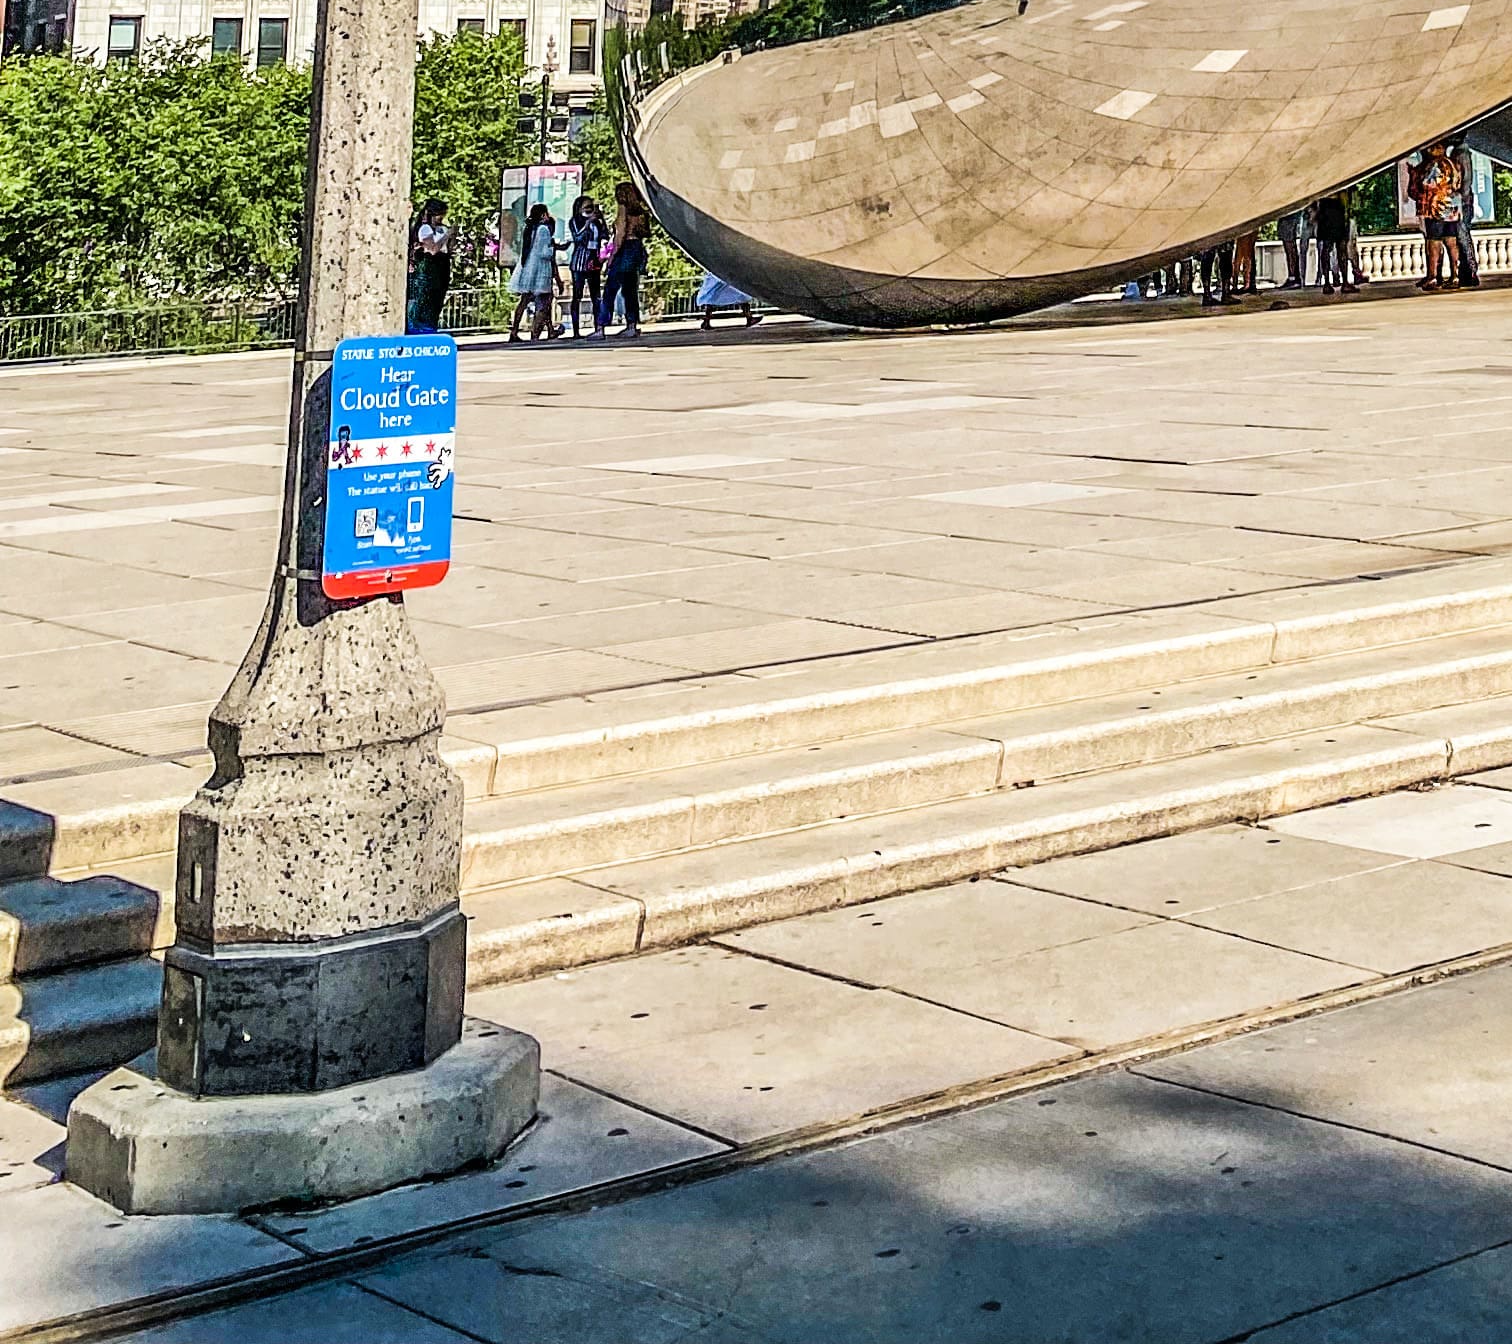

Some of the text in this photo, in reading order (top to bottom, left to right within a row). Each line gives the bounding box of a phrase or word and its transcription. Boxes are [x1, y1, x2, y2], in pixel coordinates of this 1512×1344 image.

[342, 349, 375, 360] STATUE
[414, 345, 451, 356] CHICAGO
[381, 366, 415, 383] Hear
[340, 384, 449, 410] Cloud Gate
[380, 412, 412, 428] here
[347, 486, 362, 496] The
